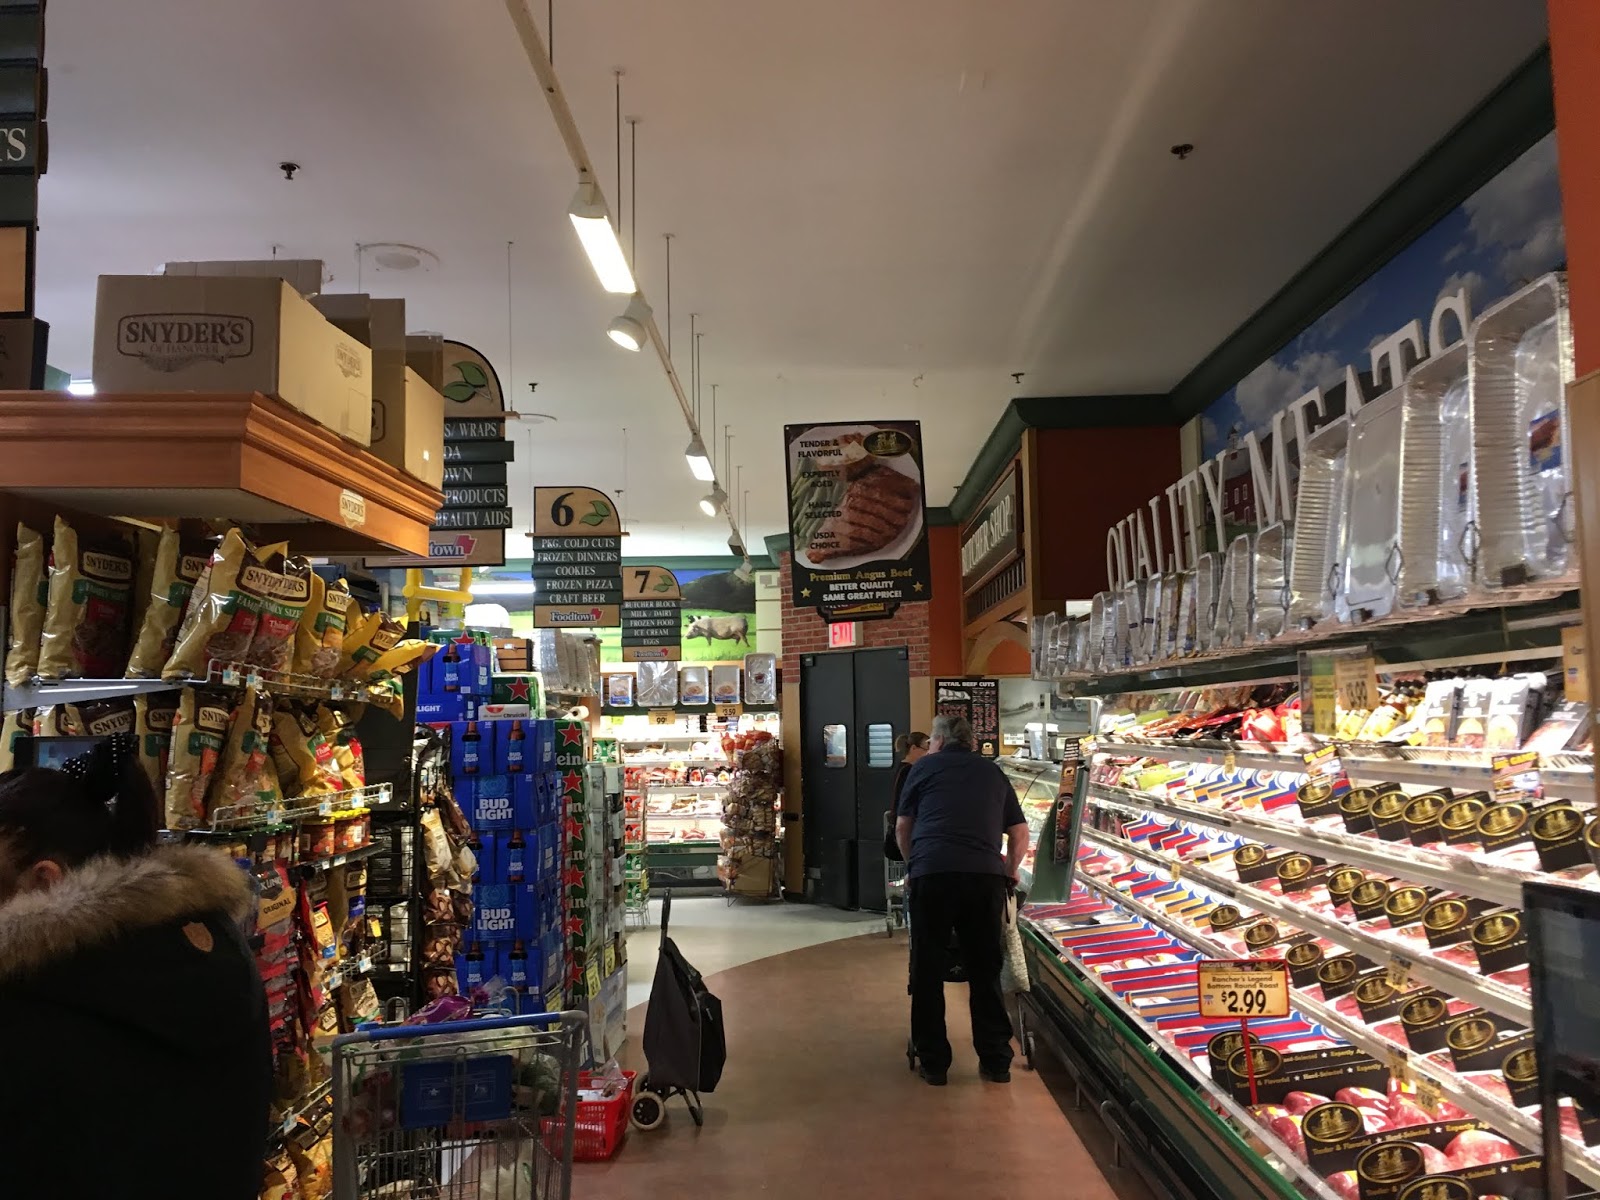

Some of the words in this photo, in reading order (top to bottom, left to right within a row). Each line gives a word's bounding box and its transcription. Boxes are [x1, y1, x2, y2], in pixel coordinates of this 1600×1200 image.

[460, 422, 497, 438] WRAPS
[799, 440, 830, 449] TENDER
[832, 439, 840, 447] &
[798, 449, 843, 459] FLAVORFUL
[445, 488, 506, 504] PRODUCTS
[551, 491, 574, 527] 6
[808, 501, 833, 509] HAND
[435, 511, 480, 527] BEAUTY
[482, 510, 511, 526] AIDS
[804, 510, 842, 520] SELECTED
[813, 531, 836, 540] USDA
[541, 538, 561, 548] PKG.
[564, 538, 589, 548] COLD
[592, 538, 615, 548] CUTS
[810, 541, 841, 550] CHOICE
[537, 552, 574, 562] FROZEN
[577, 552, 618, 561] DINNERS
[555, 566, 596, 576] COOKIES
[809, 572, 851, 582] Premium
[855, 570, 886, 581] Angus
[890, 567, 913, 578] Beef
[546, 580, 583, 590] FROZEN
[586, 579, 613, 589] PIZZA
[634, 570, 651, 594] 7
[829, 583, 858, 592] BETTER
[860, 581, 894, 591] QUALITY
[549, 594, 579, 604] CRAFT
[582, 593, 606, 603] BEER
[822, 593, 846, 602] SAME
[847, 592, 874, 601] GREAT
[875, 591, 902, 600] PRICE!
[625, 601, 654, 609] BUTCHER
[655, 600, 677, 608] BLOCK
[551, 611, 597, 622] Foodtown
[630, 610, 647, 618] MILK
[653, 609, 672, 617] DAIRY
[630, 619, 655, 627] FROZEN
[634, 629, 645, 637] ICE
[646, 628, 669, 636] CREAM
[832, 622, 852, 646] EXIT
[480, 798, 509, 809] BUD
[475, 808, 514, 820] LIGHT
[263, 898, 292, 914] ORIGINAL
[481, 908, 511, 920] BUD
[477, 918, 515, 931] LIGHT
[1247, 975, 1273, 984] Legend
[1221, 989, 1267, 1014] $2.99
